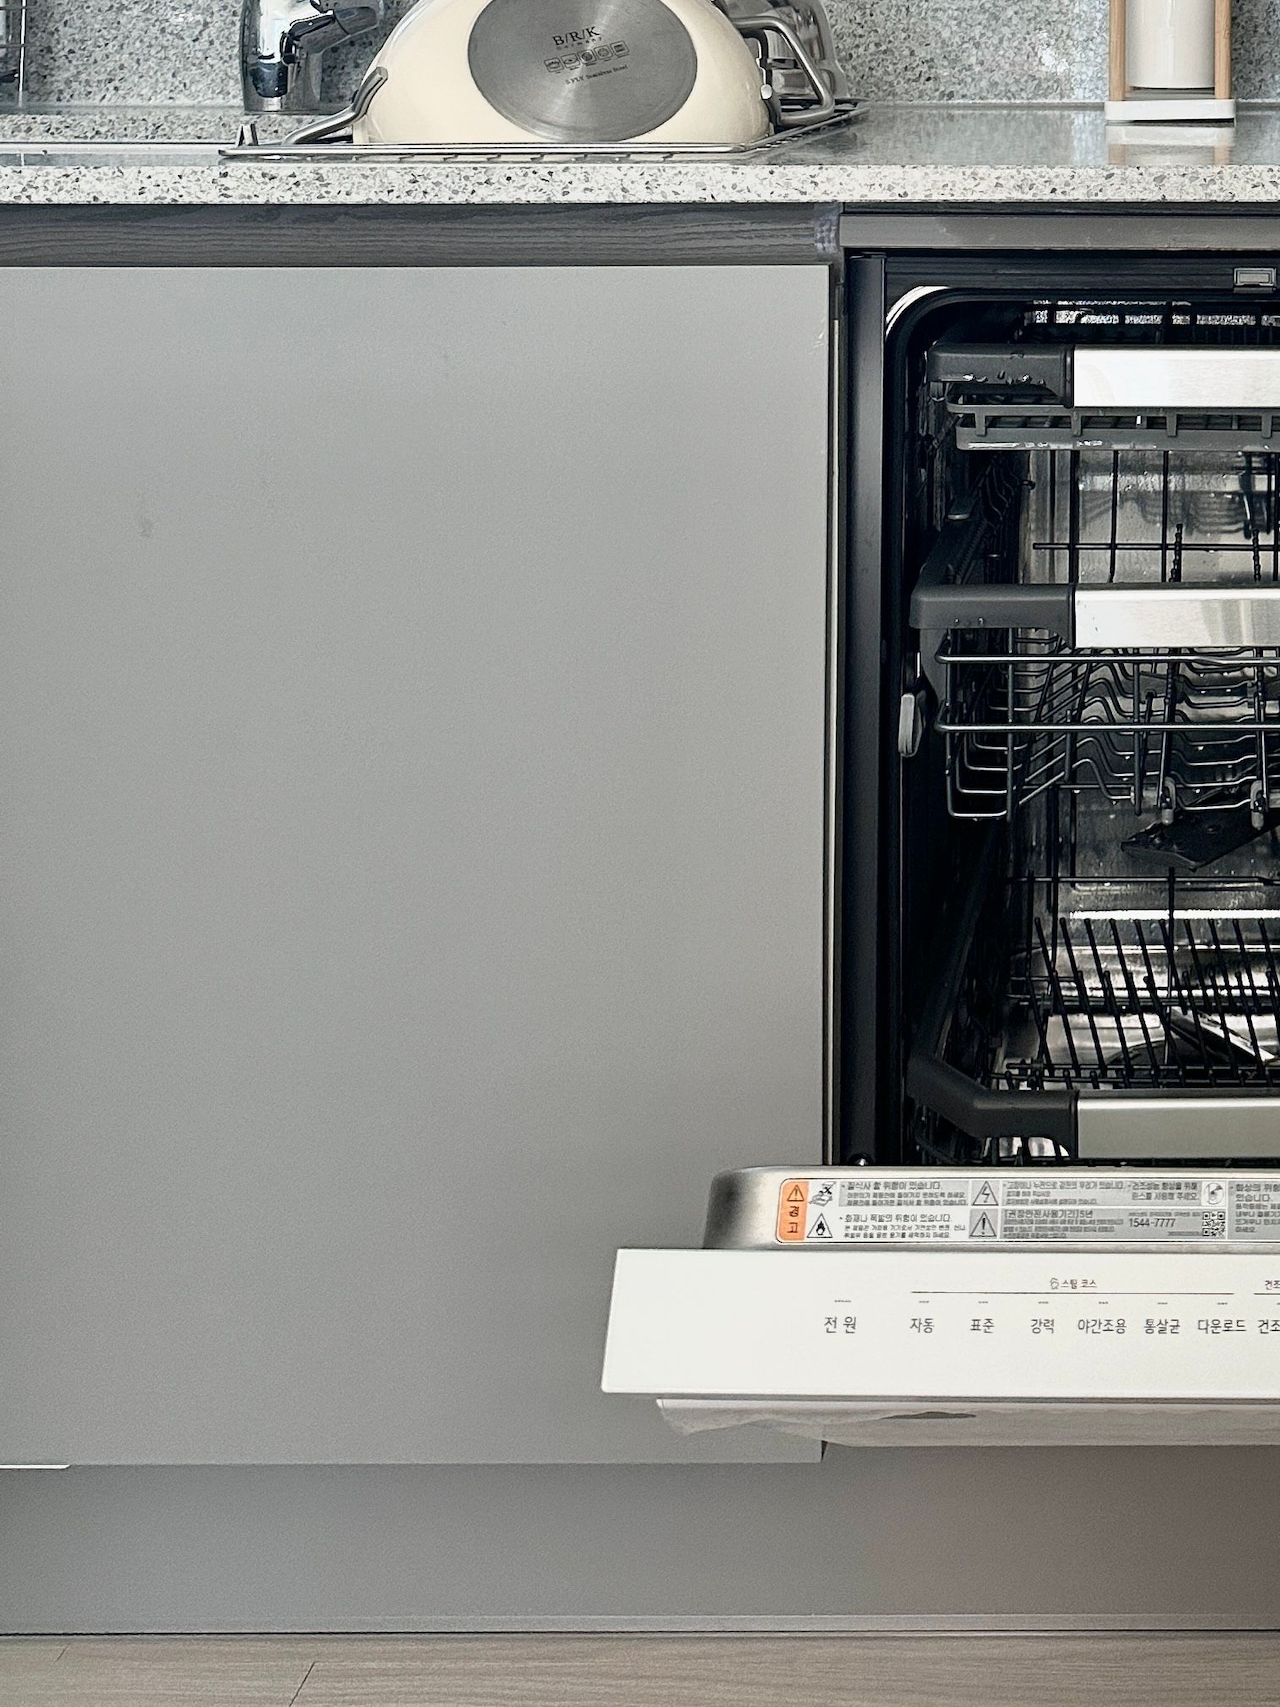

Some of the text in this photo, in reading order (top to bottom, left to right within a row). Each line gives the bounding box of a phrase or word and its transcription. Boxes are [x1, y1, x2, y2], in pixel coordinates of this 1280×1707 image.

[552, 26, 600, 45] B/R/K
[1129, 1218, 1176, 1227] 1544-7777
[1265, 1280, 1280, 1289] 건조
[910, 1318, 934, 1333] 자동
[970, 1319, 994, 1333] 표준
[1030, 1319, 1055, 1334] 강력
[1077, 1319, 1127, 1334] 야간조용
[1144, 1319, 1180, 1334] 통살균
[1198, 1319, 1246, 1334] 다운로드
